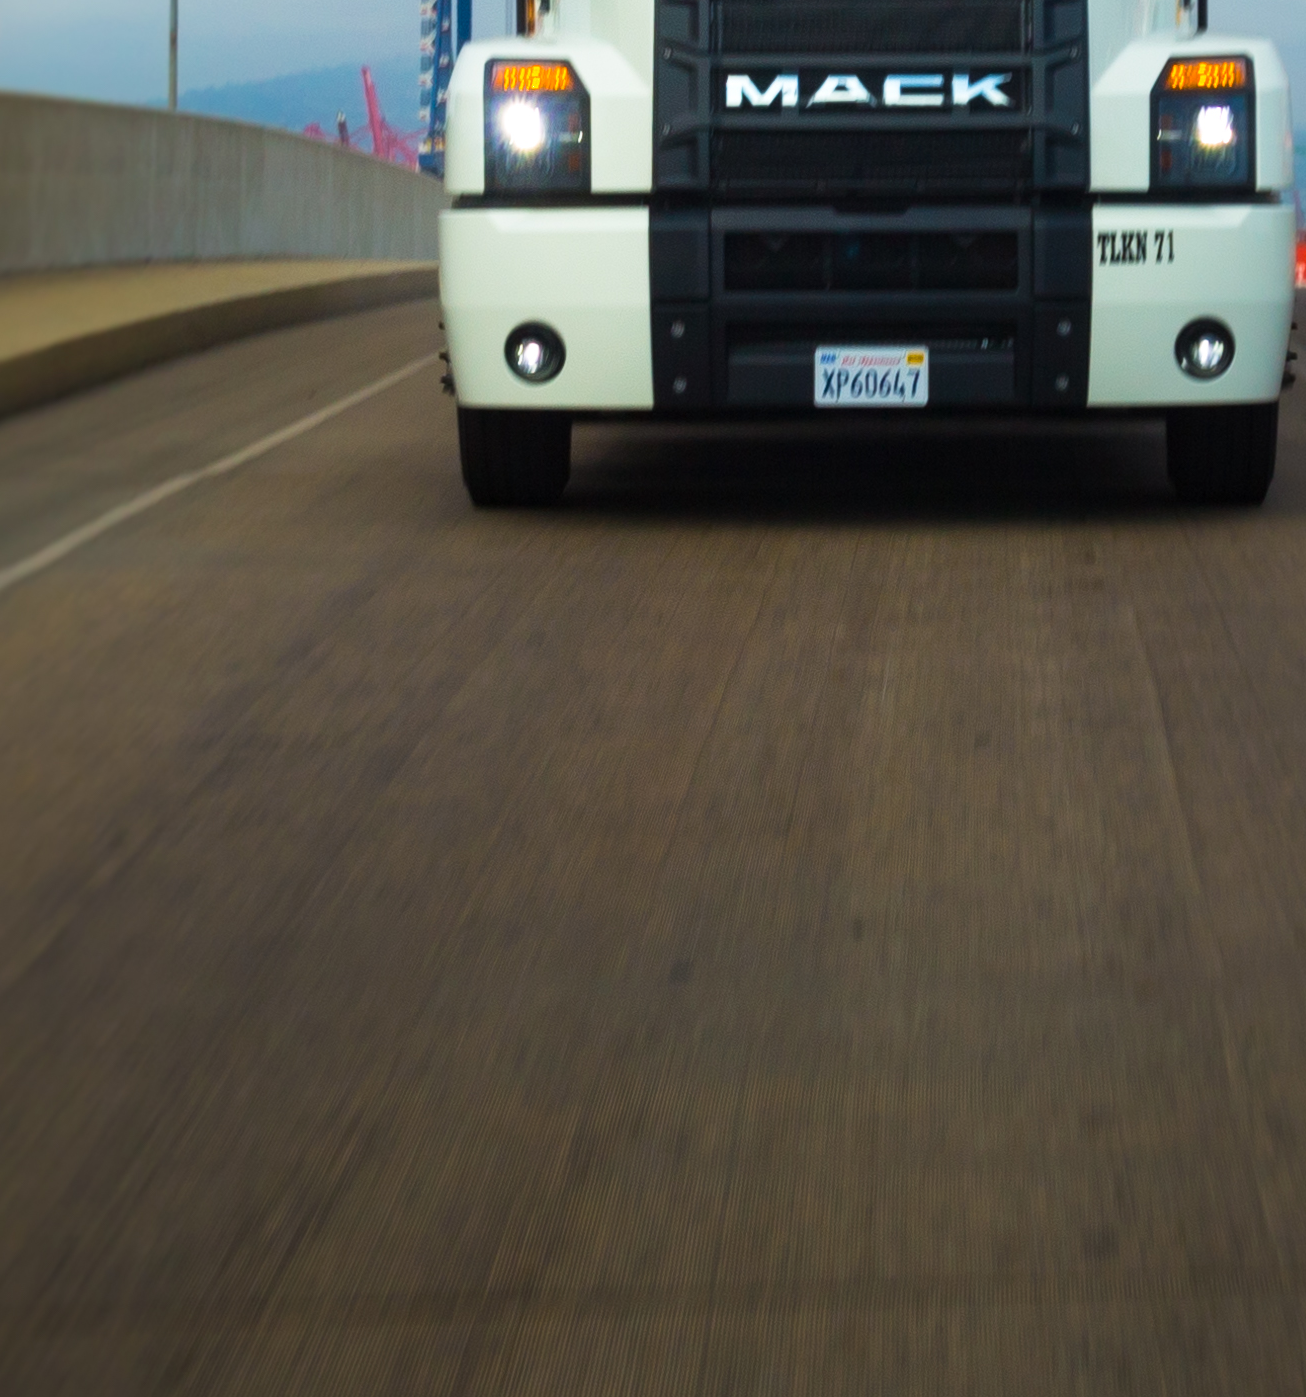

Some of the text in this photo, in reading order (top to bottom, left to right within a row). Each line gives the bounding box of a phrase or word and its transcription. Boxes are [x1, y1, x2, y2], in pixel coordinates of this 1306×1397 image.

[725, 73, 1013, 108] MACK
[1097, 228, 1175, 265] TLKN 71
[821, 367, 922, 400] XP60647
